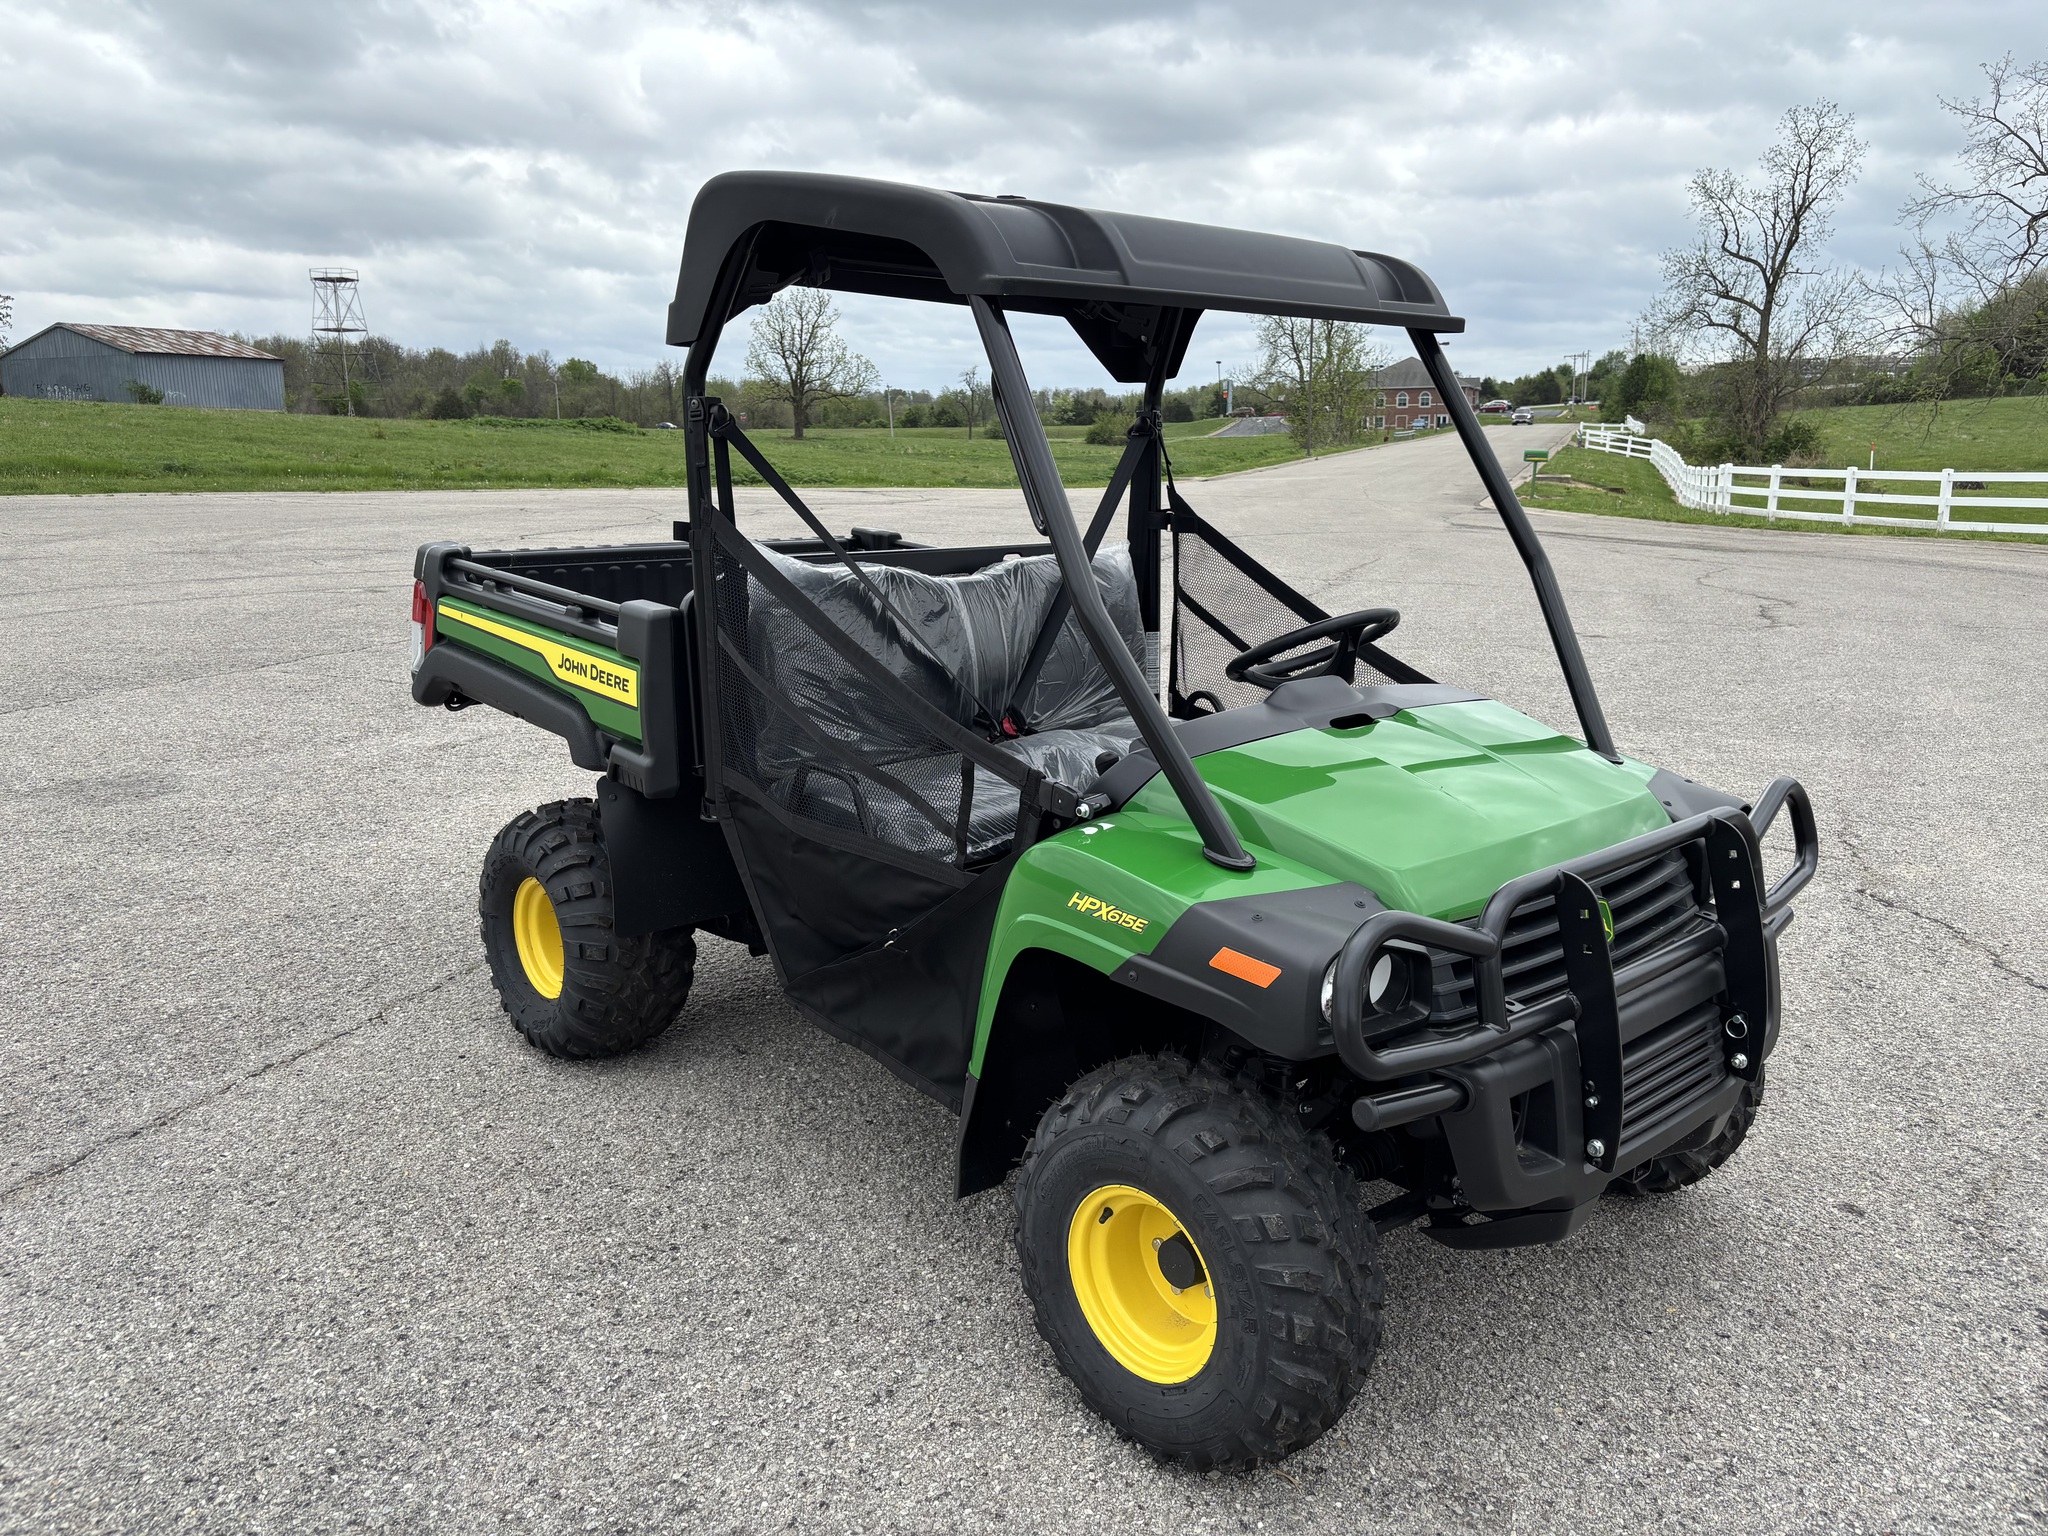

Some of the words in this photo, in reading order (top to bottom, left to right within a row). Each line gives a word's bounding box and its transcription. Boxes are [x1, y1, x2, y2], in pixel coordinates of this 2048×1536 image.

[557, 653, 588, 678] JOHN
[590, 663, 629, 693] DEERE
[1066, 891, 1149, 933] HPX615E
